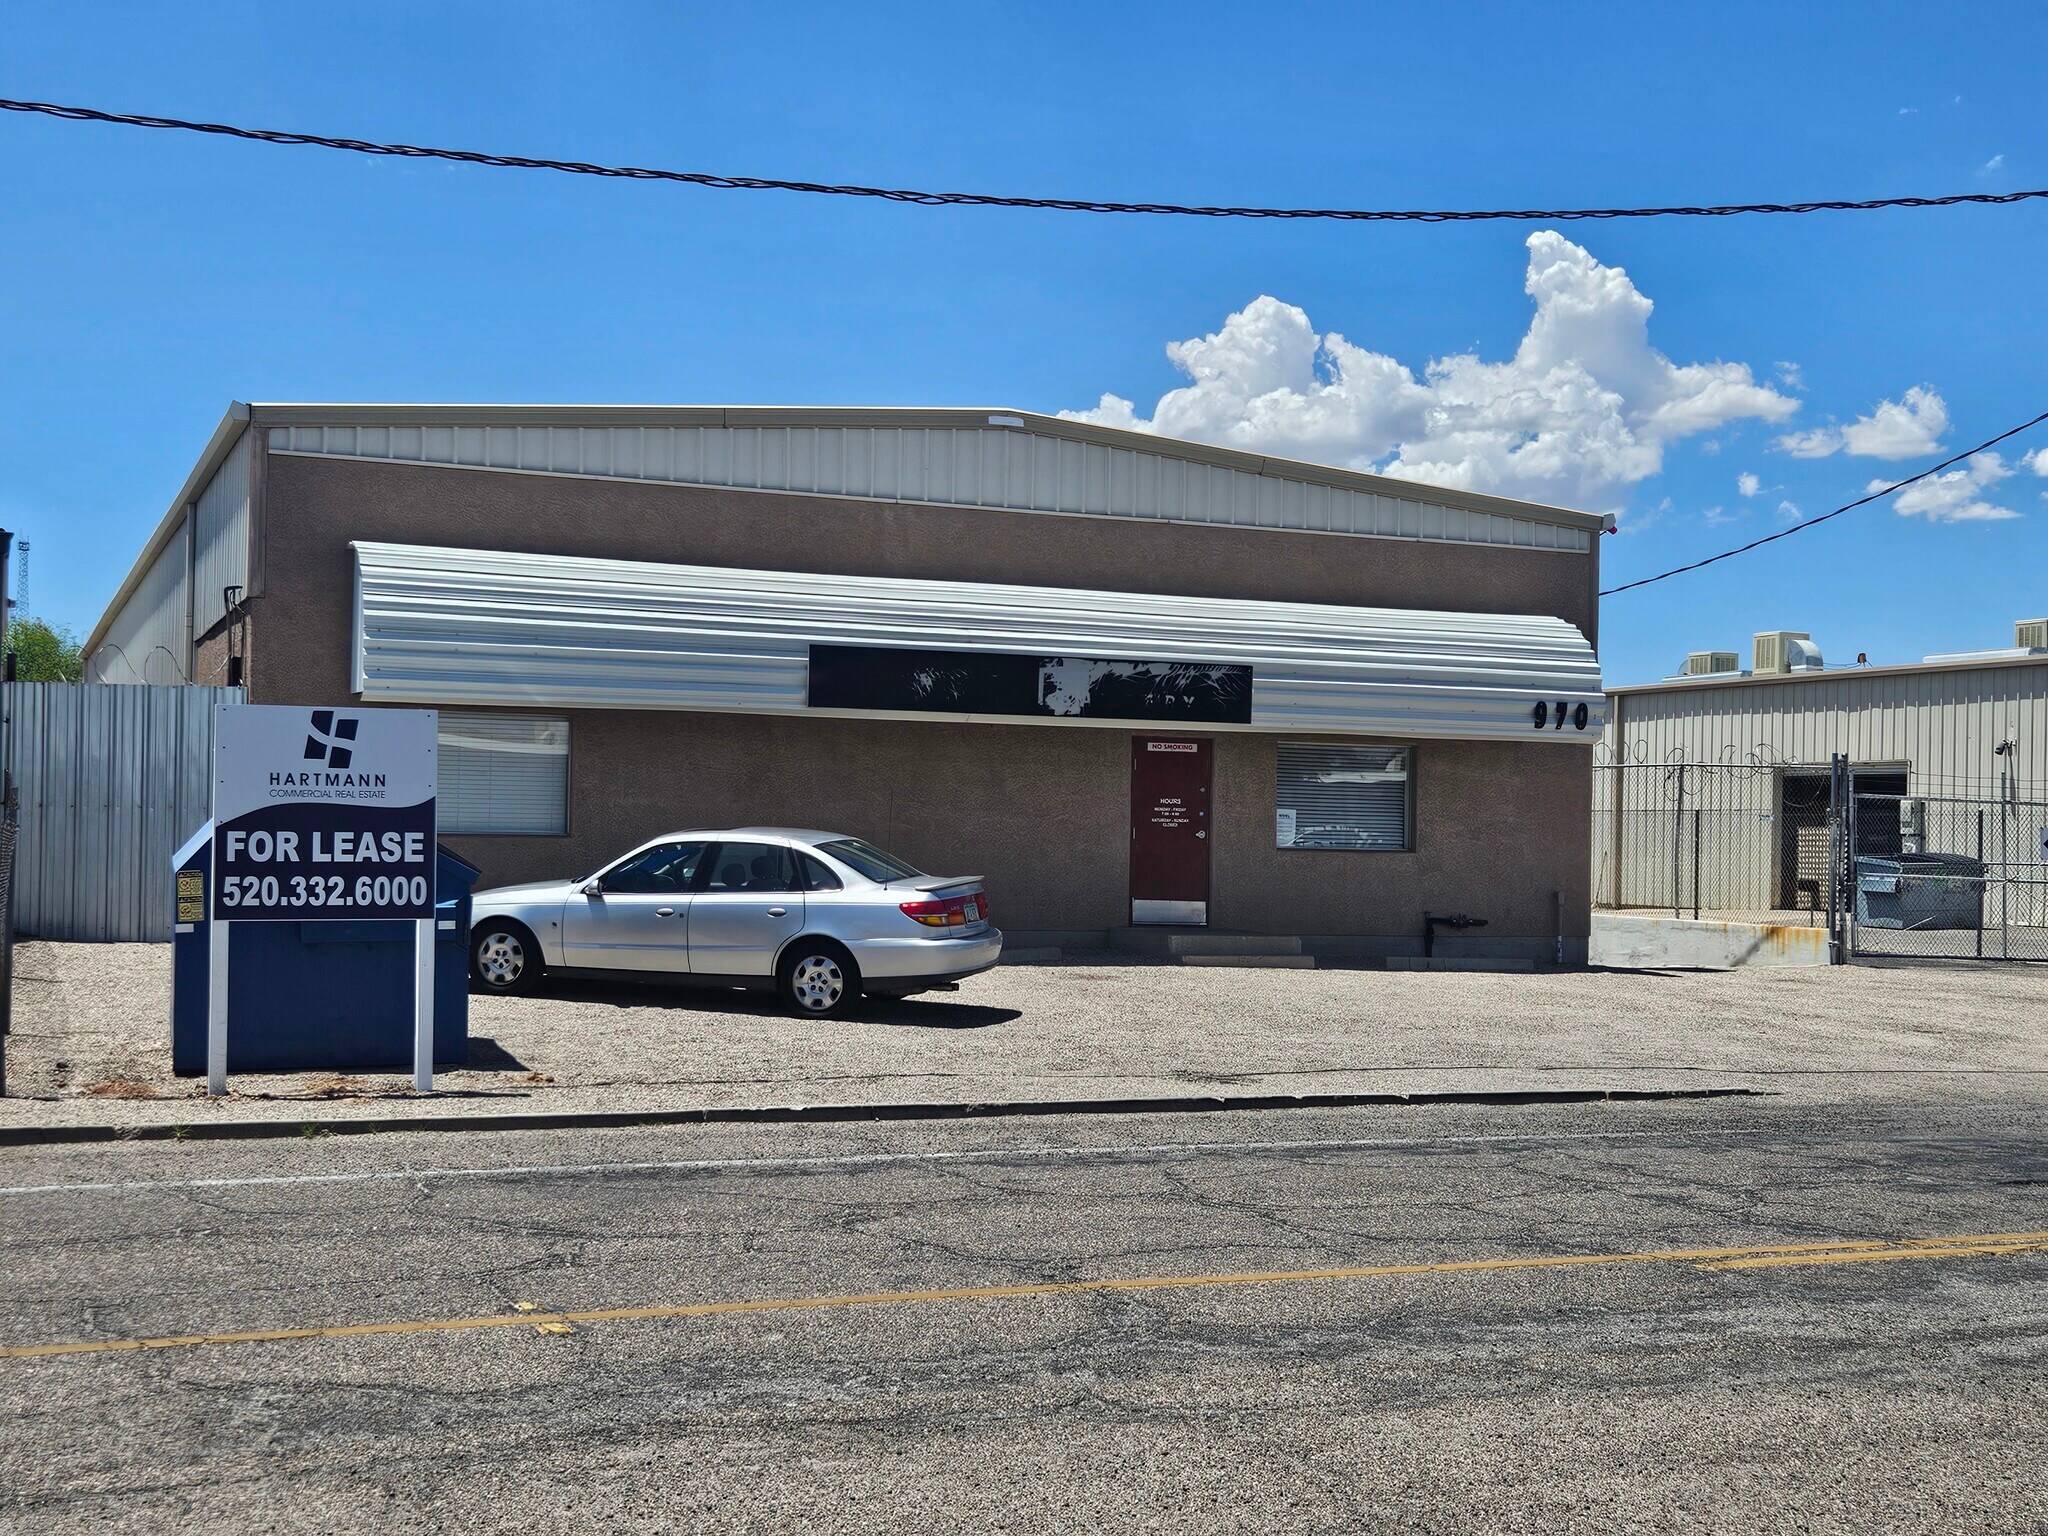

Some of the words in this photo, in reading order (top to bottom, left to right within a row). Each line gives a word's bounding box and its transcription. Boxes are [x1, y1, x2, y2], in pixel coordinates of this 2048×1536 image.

[1534, 701, 1588, 731] 970
[269, 772, 386, 787] HARTMANN
[269, 789, 333, 798] COMMERCIAL
[335, 790, 356, 798] REAL
[358, 790, 386, 799] ESTATE
[226, 830, 300, 862] FOR
[312, 831, 425, 863] LEASE
[222, 875, 428, 907] 520.332.6000
